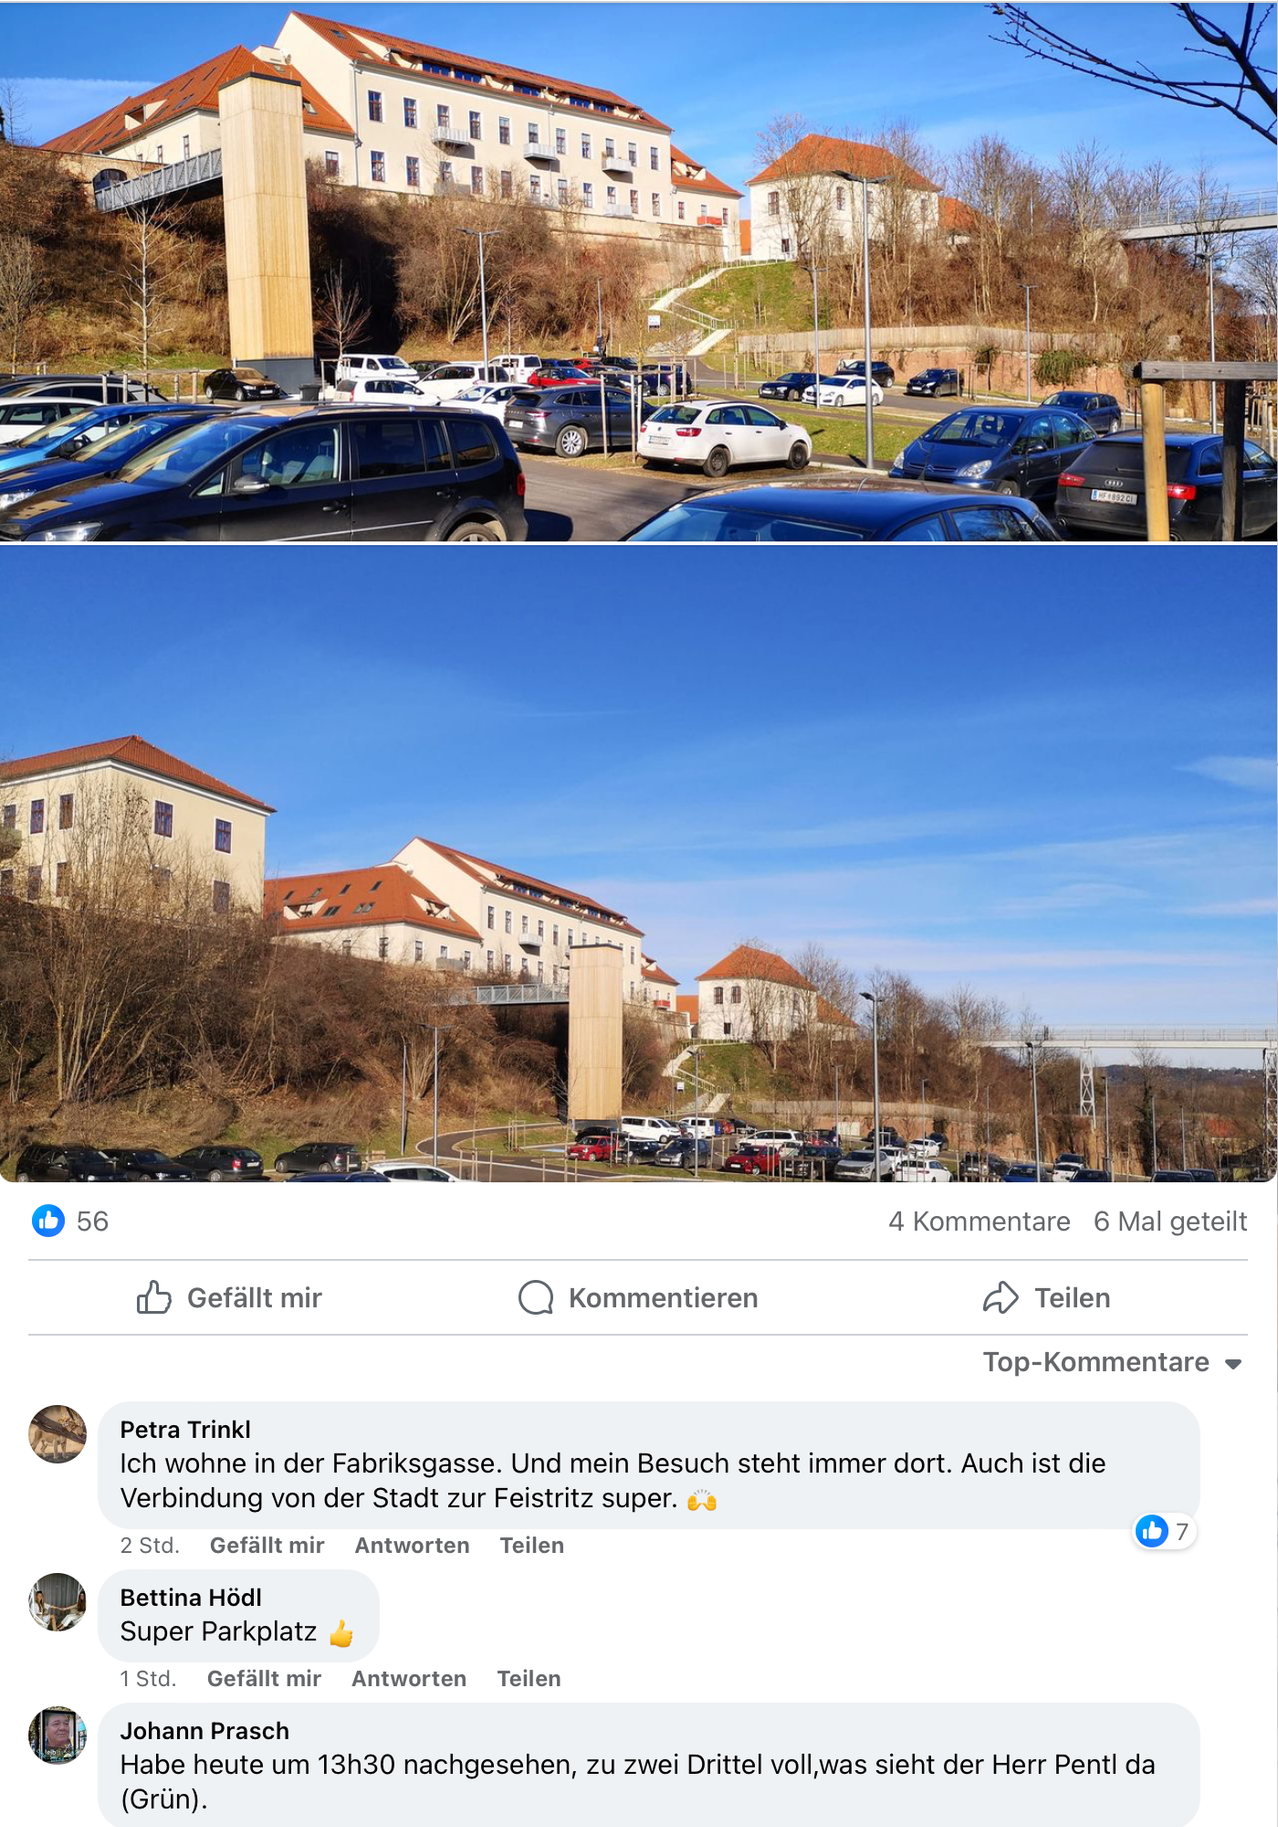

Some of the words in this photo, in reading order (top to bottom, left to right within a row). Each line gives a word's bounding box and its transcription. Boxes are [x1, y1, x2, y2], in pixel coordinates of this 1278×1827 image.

[78, 1211, 108, 1231] 56
[889, 1211, 904, 1231] 4
[915, 1211, 1070, 1231] Kommentare
[1095, 1211, 1109, 1231] 6
[1120, 1210, 1160, 1231] Mal
[1171, 1210, 1247, 1236] geteilt
[188, 1287, 272, 1308] Gefällt
[282, 1286, 322, 1307] mir
[571, 1286, 757, 1308] Kommentieren
[1035, 1286, 1109, 1308] Teilen
[983, 1352, 1209, 1376] Top-Kommentare
[121, 1420, 179, 1438] Petra
[187, 1419, 250, 1438] Trinkl
[122, 1452, 155, 1473] Ich
[165, 1452, 246, 1473] wohne
[255, 1452, 274, 1473] in
[284, 1452, 324, 1473] der
[334, 1452, 501, 1478] Fabriksgasse.
[512, 1452, 560, 1473] Und
[571, 1452, 628, 1473] mein
[639, 1452, 728, 1473] Besuch
[738, 1452, 800, 1473] steht
[809, 1452, 886, 1473] immer
[894, 1452, 951, 1473] dort.
[961, 1452, 1023, 1473] Auch
[1033, 1452, 1060, 1473] ist
[1069, 1452, 1105, 1473] die
[120, 1487, 262, 1513] Verbindung
[272, 1492, 315, 1508] von
[324, 1487, 365, 1508] der
[373, 1487, 438, 1508] Stadt
[448, 1492, 486, 1508] zur
[495, 1487, 593, 1508] Feistritz
[602, 1492, 677, 1512] super.
[1177, 1523, 1188, 1540] 7
[121, 1537, 131, 1553] 2
[140, 1537, 178, 1553] Std.
[211, 1536, 282, 1553] Gefällt
[290, 1536, 324, 1553] mir
[355, 1537, 469, 1553] Antworten
[500, 1536, 563, 1553] Teilen
[121, 1587, 201, 1606] Bettina
[210, 1588, 261, 1606] Hödl
[121, 1620, 194, 1646] Super
[203, 1620, 316, 1646] Parkplatz
[121, 1671, 127, 1686] 1
[137, 1670, 175, 1687] Std.
[208, 1669, 279, 1687] Gefällt
[287, 1669, 321, 1686] mir
[352, 1671, 466, 1686] Antworten
[497, 1669, 560, 1686] Teilen
[120, 1721, 203, 1740] Johann
[212, 1721, 289, 1740] Prasch
[122, 1753, 185, 1774] Habe
[194, 1753, 263, 1774] heute
[273, 1759, 309, 1774] um
[319, 1753, 395, 1775] 13h30
[405, 1753, 576, 1779] nachgesehen,
[587, 1759, 614, 1774] zu
[624, 1753, 678, 1774] zwei
[689, 1753, 761, 1774] Drittel
[771, 1753, 867, 1779] voll,was
[876, 1753, 935, 1774] sieht
[944, 1753, 984, 1774] der
[993, 1754, 1047, 1774] Herr
[1056, 1753, 1116, 1774] Pentl
[1126, 1753, 1154, 1774] da
[122, 1788, 206, 1814] (Grün).
